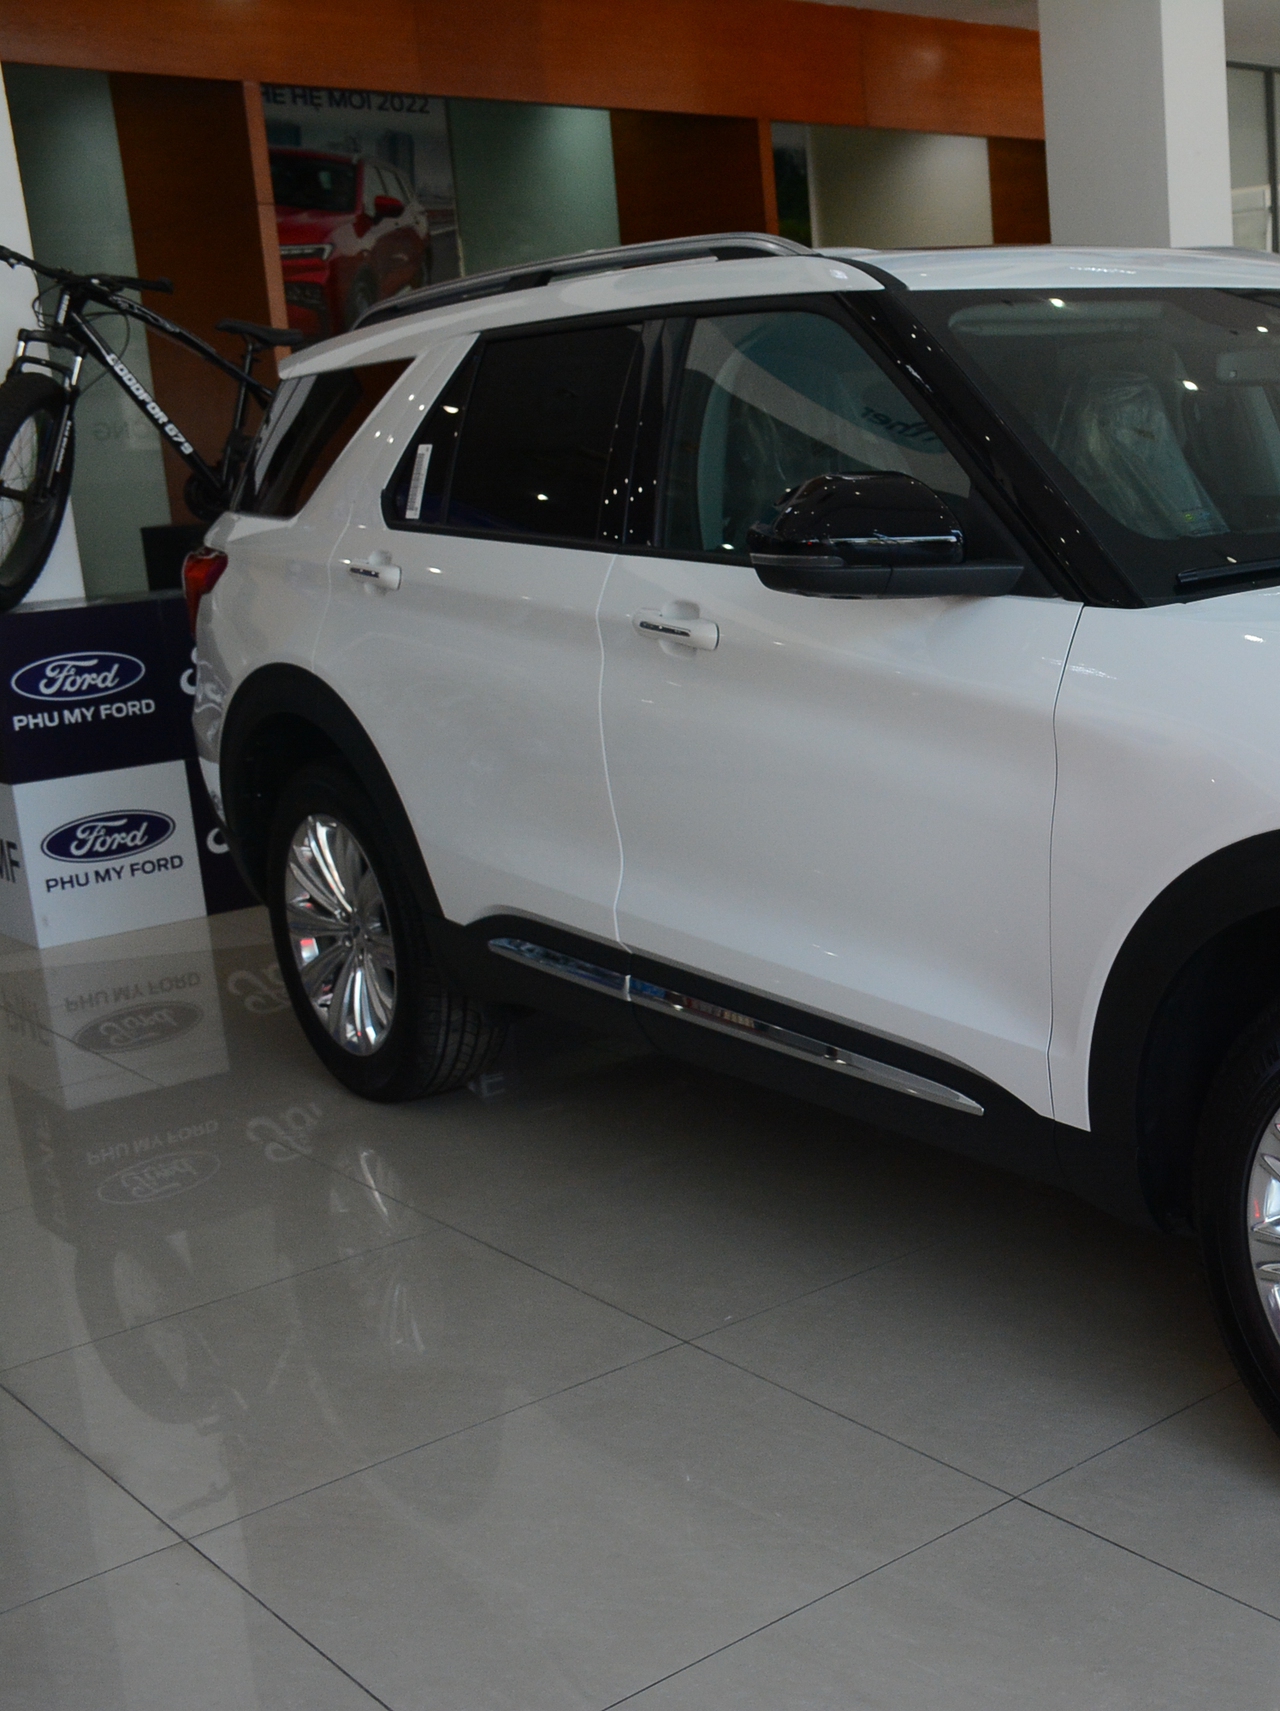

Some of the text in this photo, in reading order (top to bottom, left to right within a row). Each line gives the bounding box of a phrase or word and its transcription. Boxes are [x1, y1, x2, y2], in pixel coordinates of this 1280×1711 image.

[377, 94, 431, 114] 2022
[37, 657, 122, 697] Ford
[13, 699, 156, 731] PHU MY FORD
[68, 816, 151, 858] Ford
[45, 855, 184, 893] PHU MY FORD
